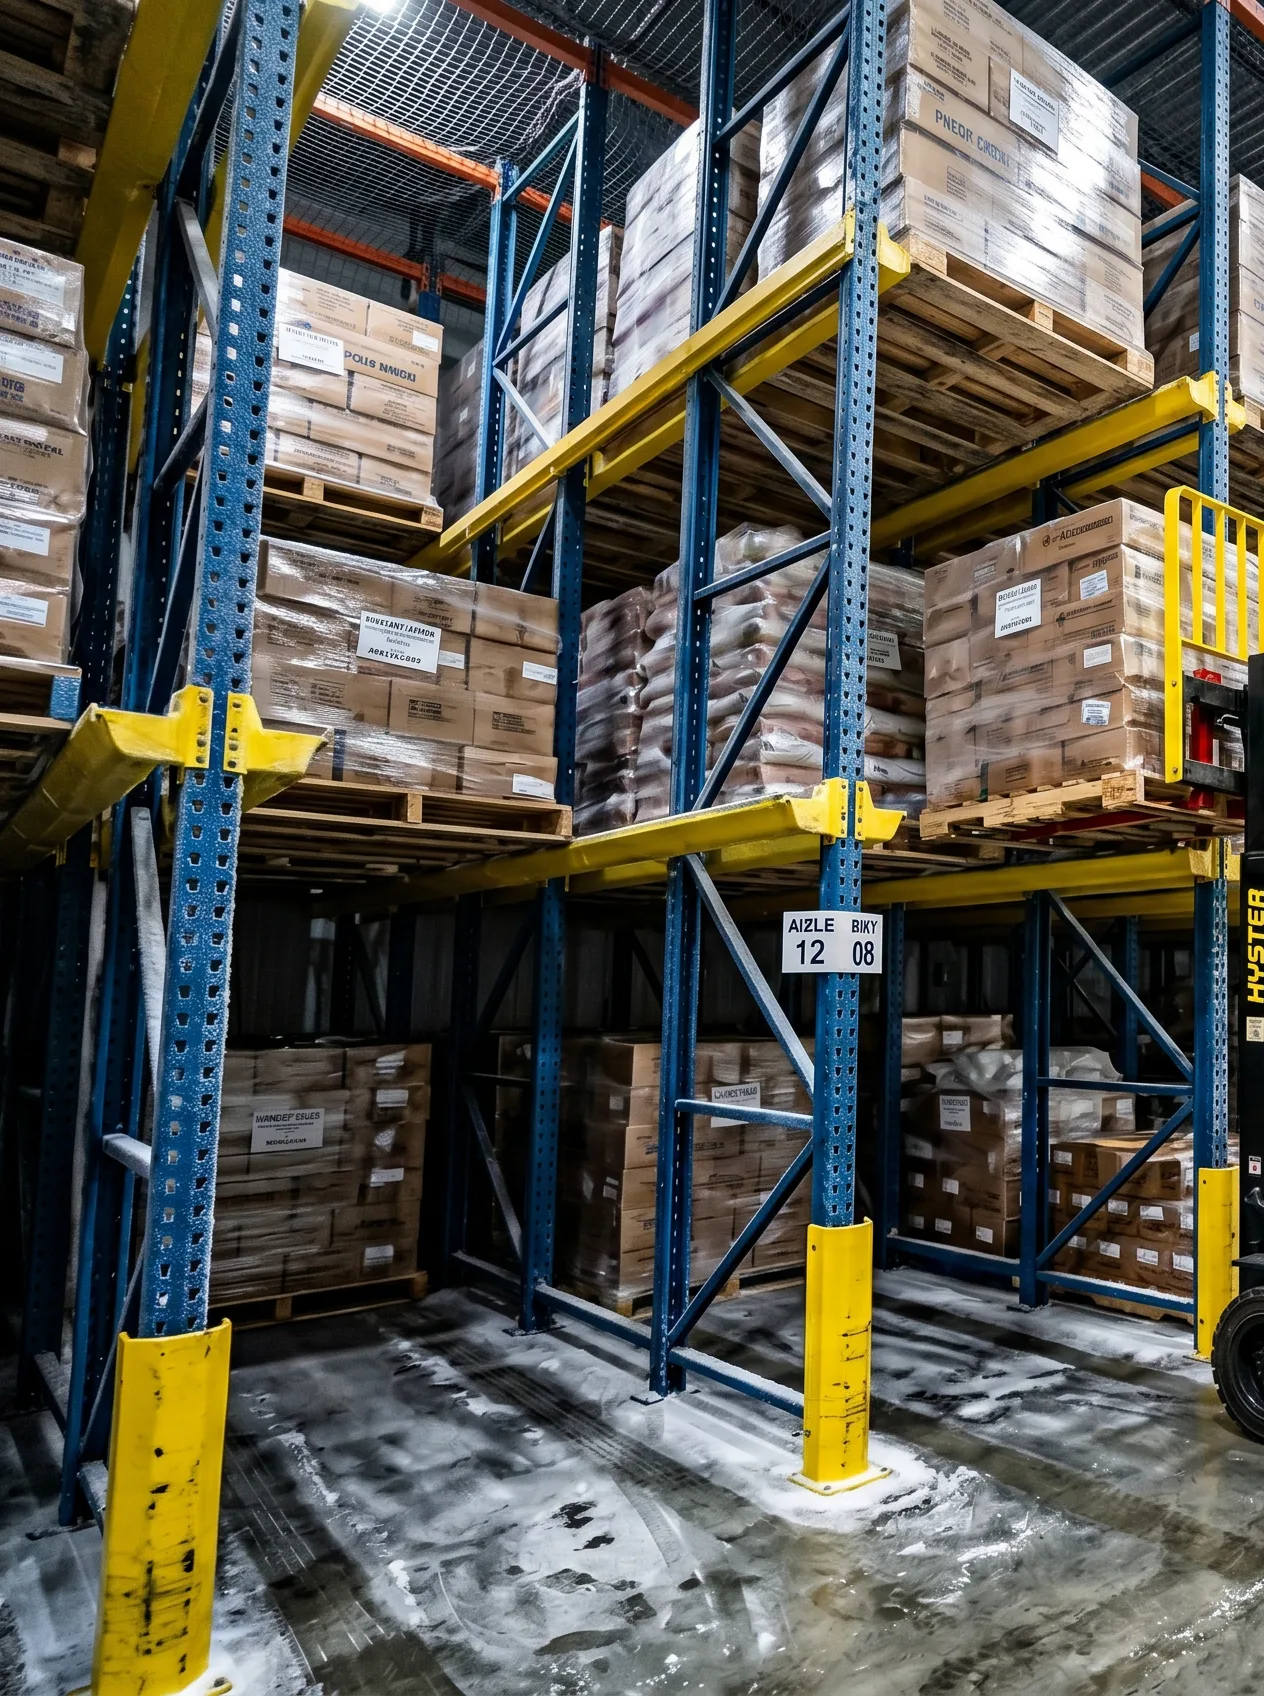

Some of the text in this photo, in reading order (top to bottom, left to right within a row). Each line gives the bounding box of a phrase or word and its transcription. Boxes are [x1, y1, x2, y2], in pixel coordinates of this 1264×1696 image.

[788, 918, 878, 934] AIZLE BIKY
[796, 939, 874, 966] 12 08
[1247, 888, 1264, 1003] HYSTER
